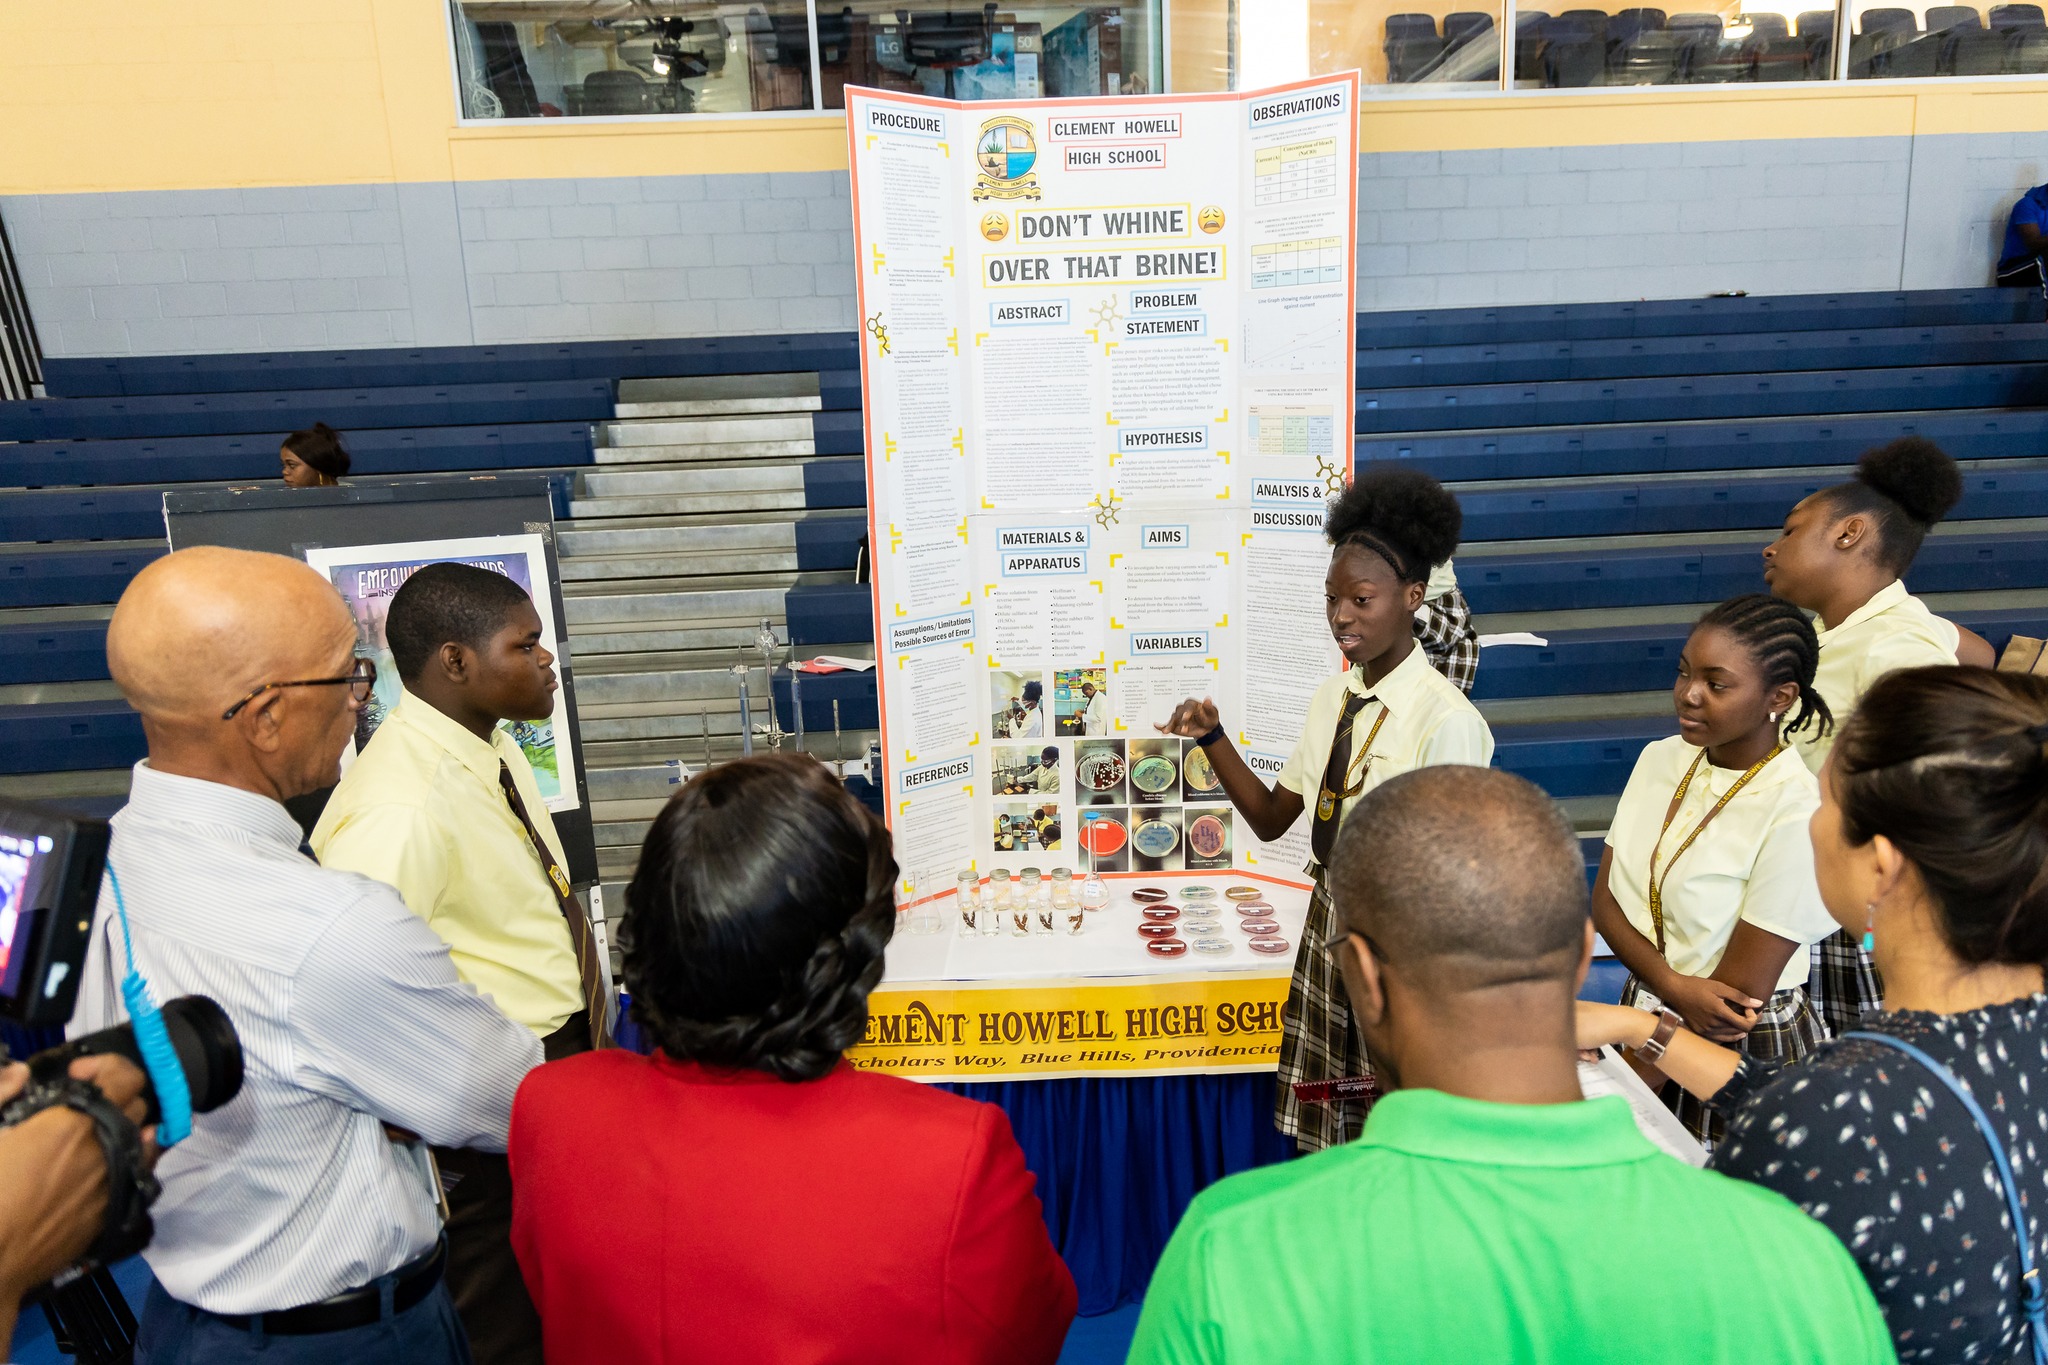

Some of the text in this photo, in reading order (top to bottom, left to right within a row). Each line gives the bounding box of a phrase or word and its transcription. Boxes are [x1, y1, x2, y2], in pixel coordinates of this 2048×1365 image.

[882, 42, 898, 54] LG
[1018, 36, 1032, 48] 50
[1254, 94, 1340, 121] OBSERVATIONS
[872, 112, 940, 132] PROCEDURE
[1054, 120, 1178, 136] CLEMENT HOWELL
[1068, 150, 1161, 164] HIGH SCHOOL
[984, 178, 1028, 186] CLEMENT HOWELL
[1022, 210, 1183, 238] DON'T WHINE
[989, 252, 1217, 282] OVER THAT BRINE!
[1135, 294, 1197, 308] PROBLEM
[998, 306, 1062, 320] ABSTRACT
[1127, 320, 1200, 334] STATEMENT
[1126, 432, 1203, 446] HYPOTHESIS
[1257, 484, 1322, 498] ANALYSIS &
[1254, 513, 1322, 526] DISCUSSION
[1003, 531, 1085, 544] MATERIALS &
[1149, 531, 1181, 542] AIMS
[1008, 557, 1080, 570] APPARATUS
[895, 638, 921, 649] Possible
[922, 634, 947, 644] Sources
[956, 629, 970, 637] Error
[1136, 637, 1202, 650] VARIABLES
[1360, 719, 1383, 756] HIGH SCHOOL
[905, 761, 969, 786] REFERENCES
[1675, 774, 1691, 800] SCHOOL
[1718, 780, 1743, 808] CLEMENT
[1743, 759, 1768, 781] HOWELL
[864, 1001, 966, 1044] EMENT
[979, 1010, 1113, 1042] HOWELL
[1126, 1005, 1205, 1037] HIGH
[954, 1056, 1006, 1068] Way,
[1020, 1053, 1072, 1064] Blue
[1078, 1051, 1136, 1062] Hills,
